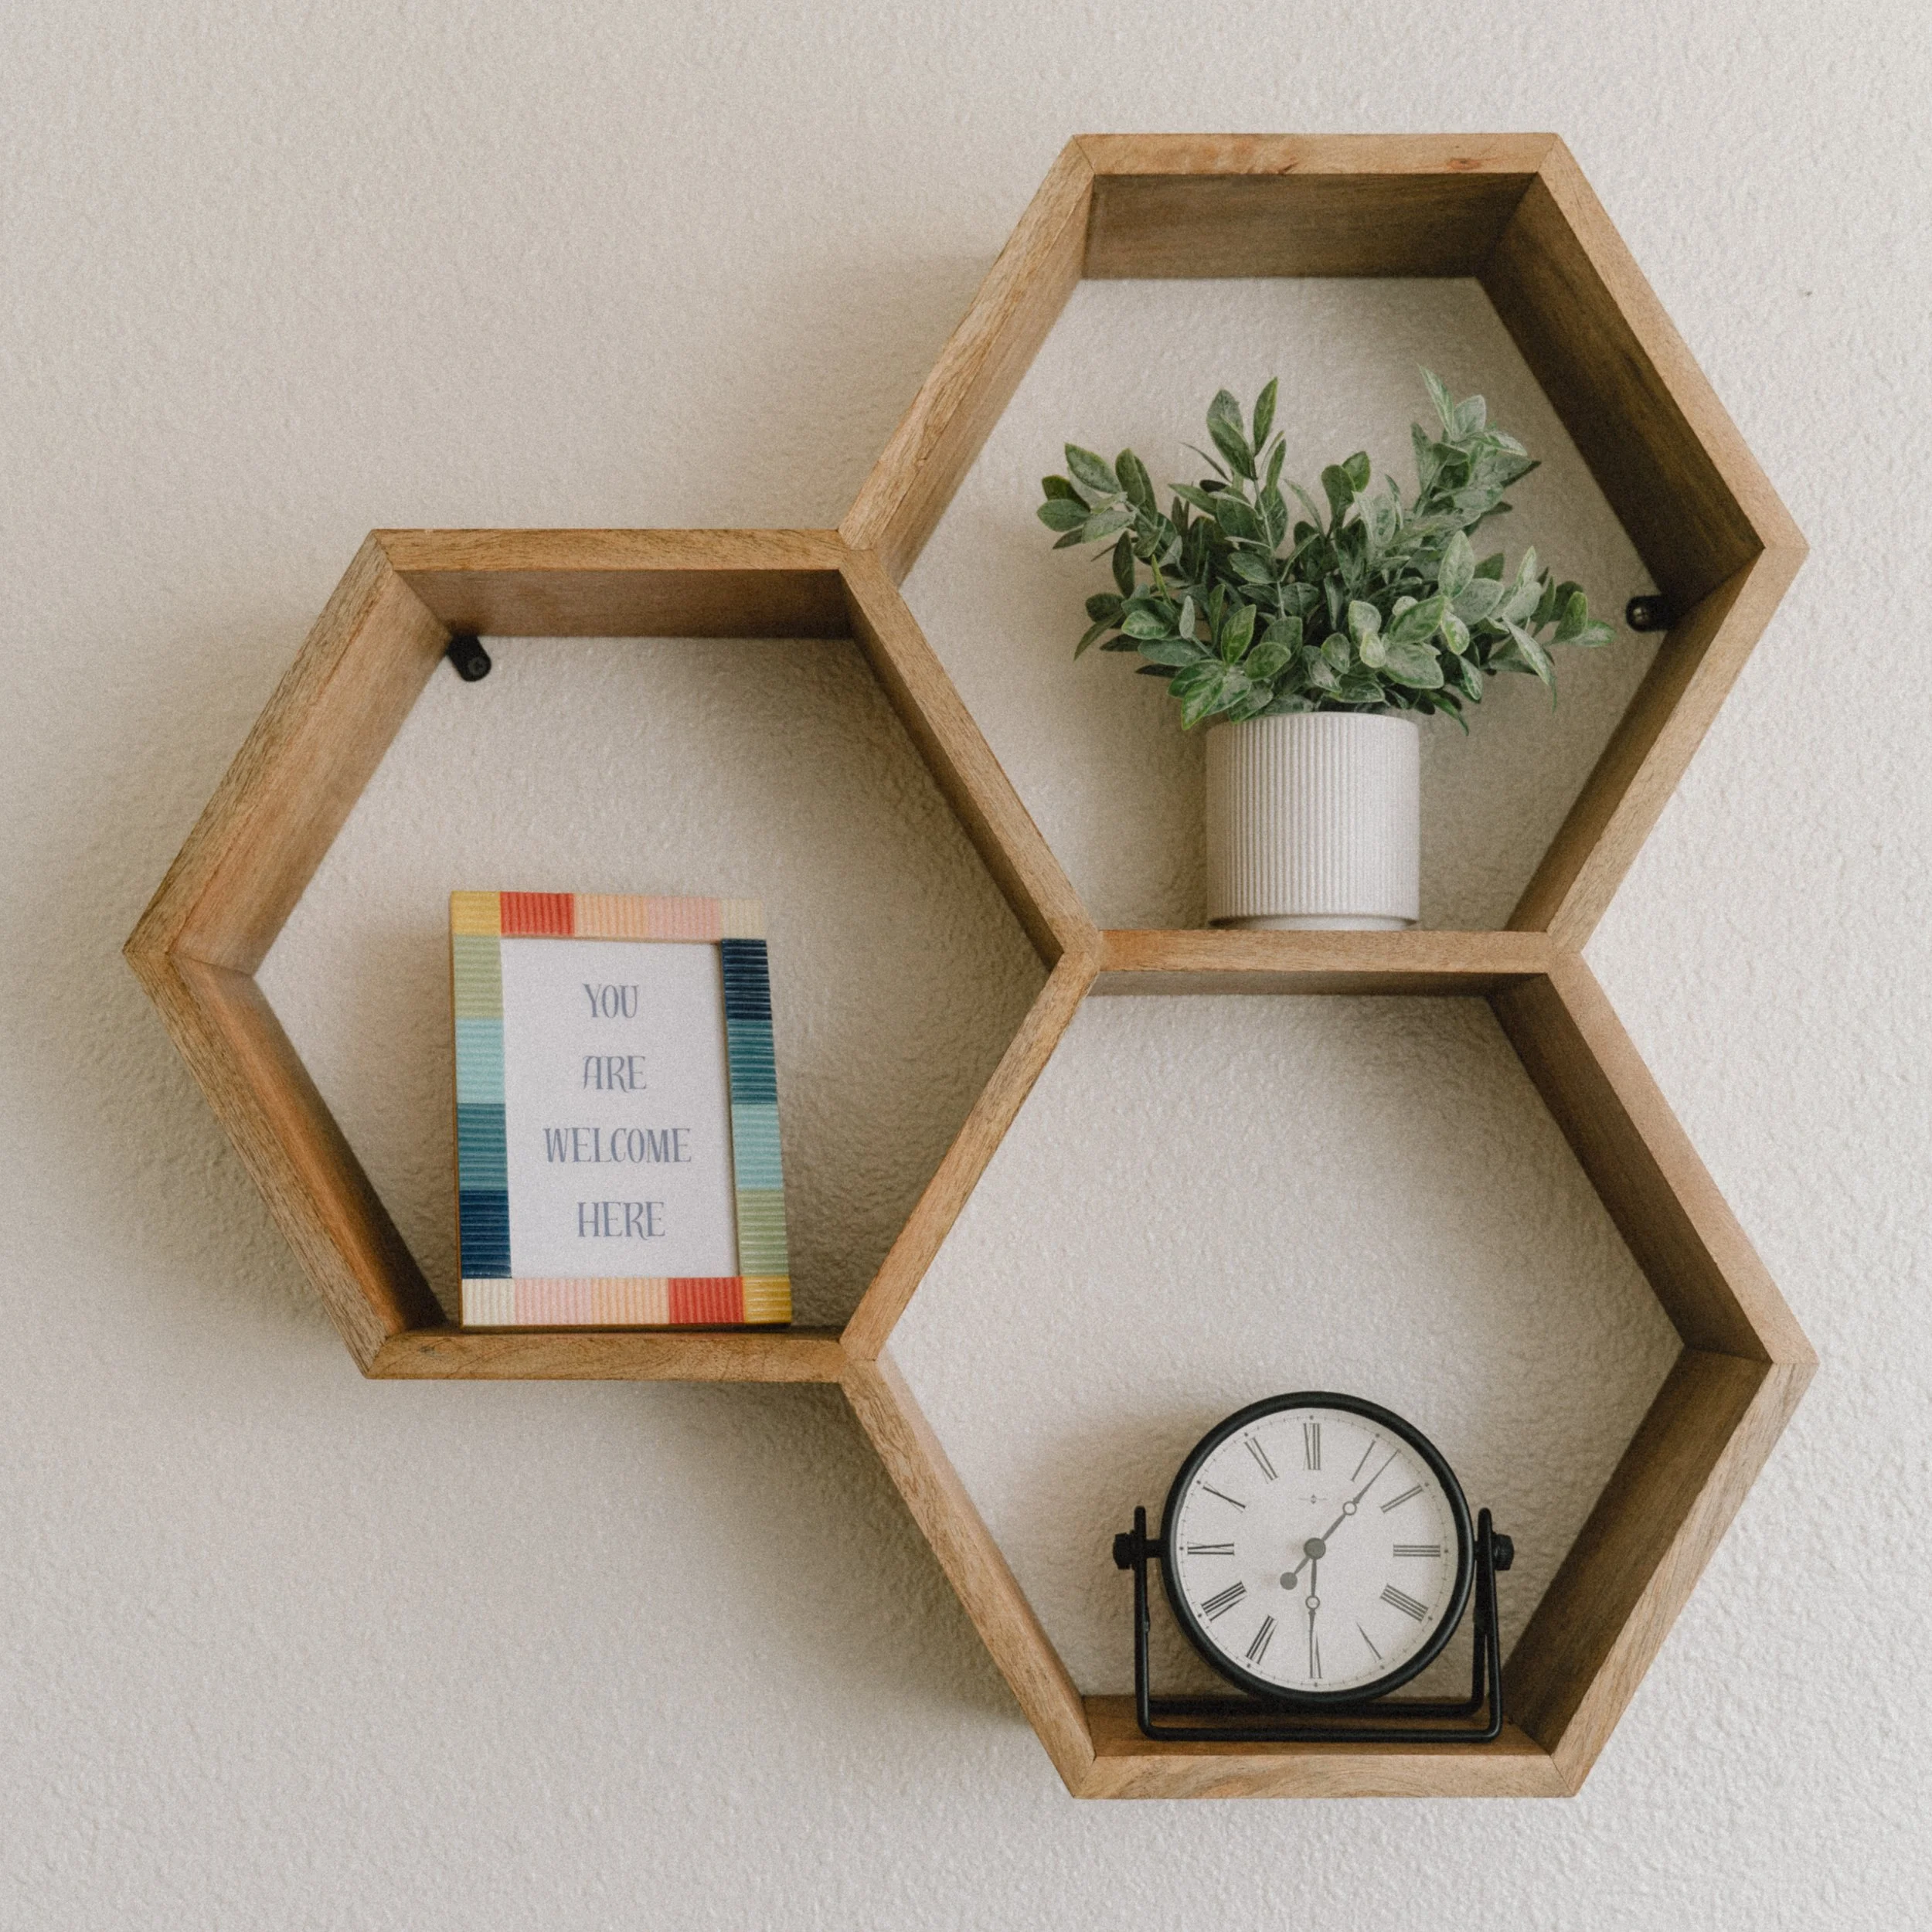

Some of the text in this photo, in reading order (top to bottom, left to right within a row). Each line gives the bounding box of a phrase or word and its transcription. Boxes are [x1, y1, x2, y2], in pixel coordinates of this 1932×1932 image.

[582, 983, 640, 1019] YOU
[582, 1055, 648, 1094] ARE
[543, 1127, 692, 1164] WELCOME
[577, 1200, 666, 1241] HERE
[1244, 1437, 1279, 1483] XI
[1303, 1423, 1321, 1471] XII
[1380, 1484, 1425, 1514] II
[1393, 1544, 1441, 1557] III
